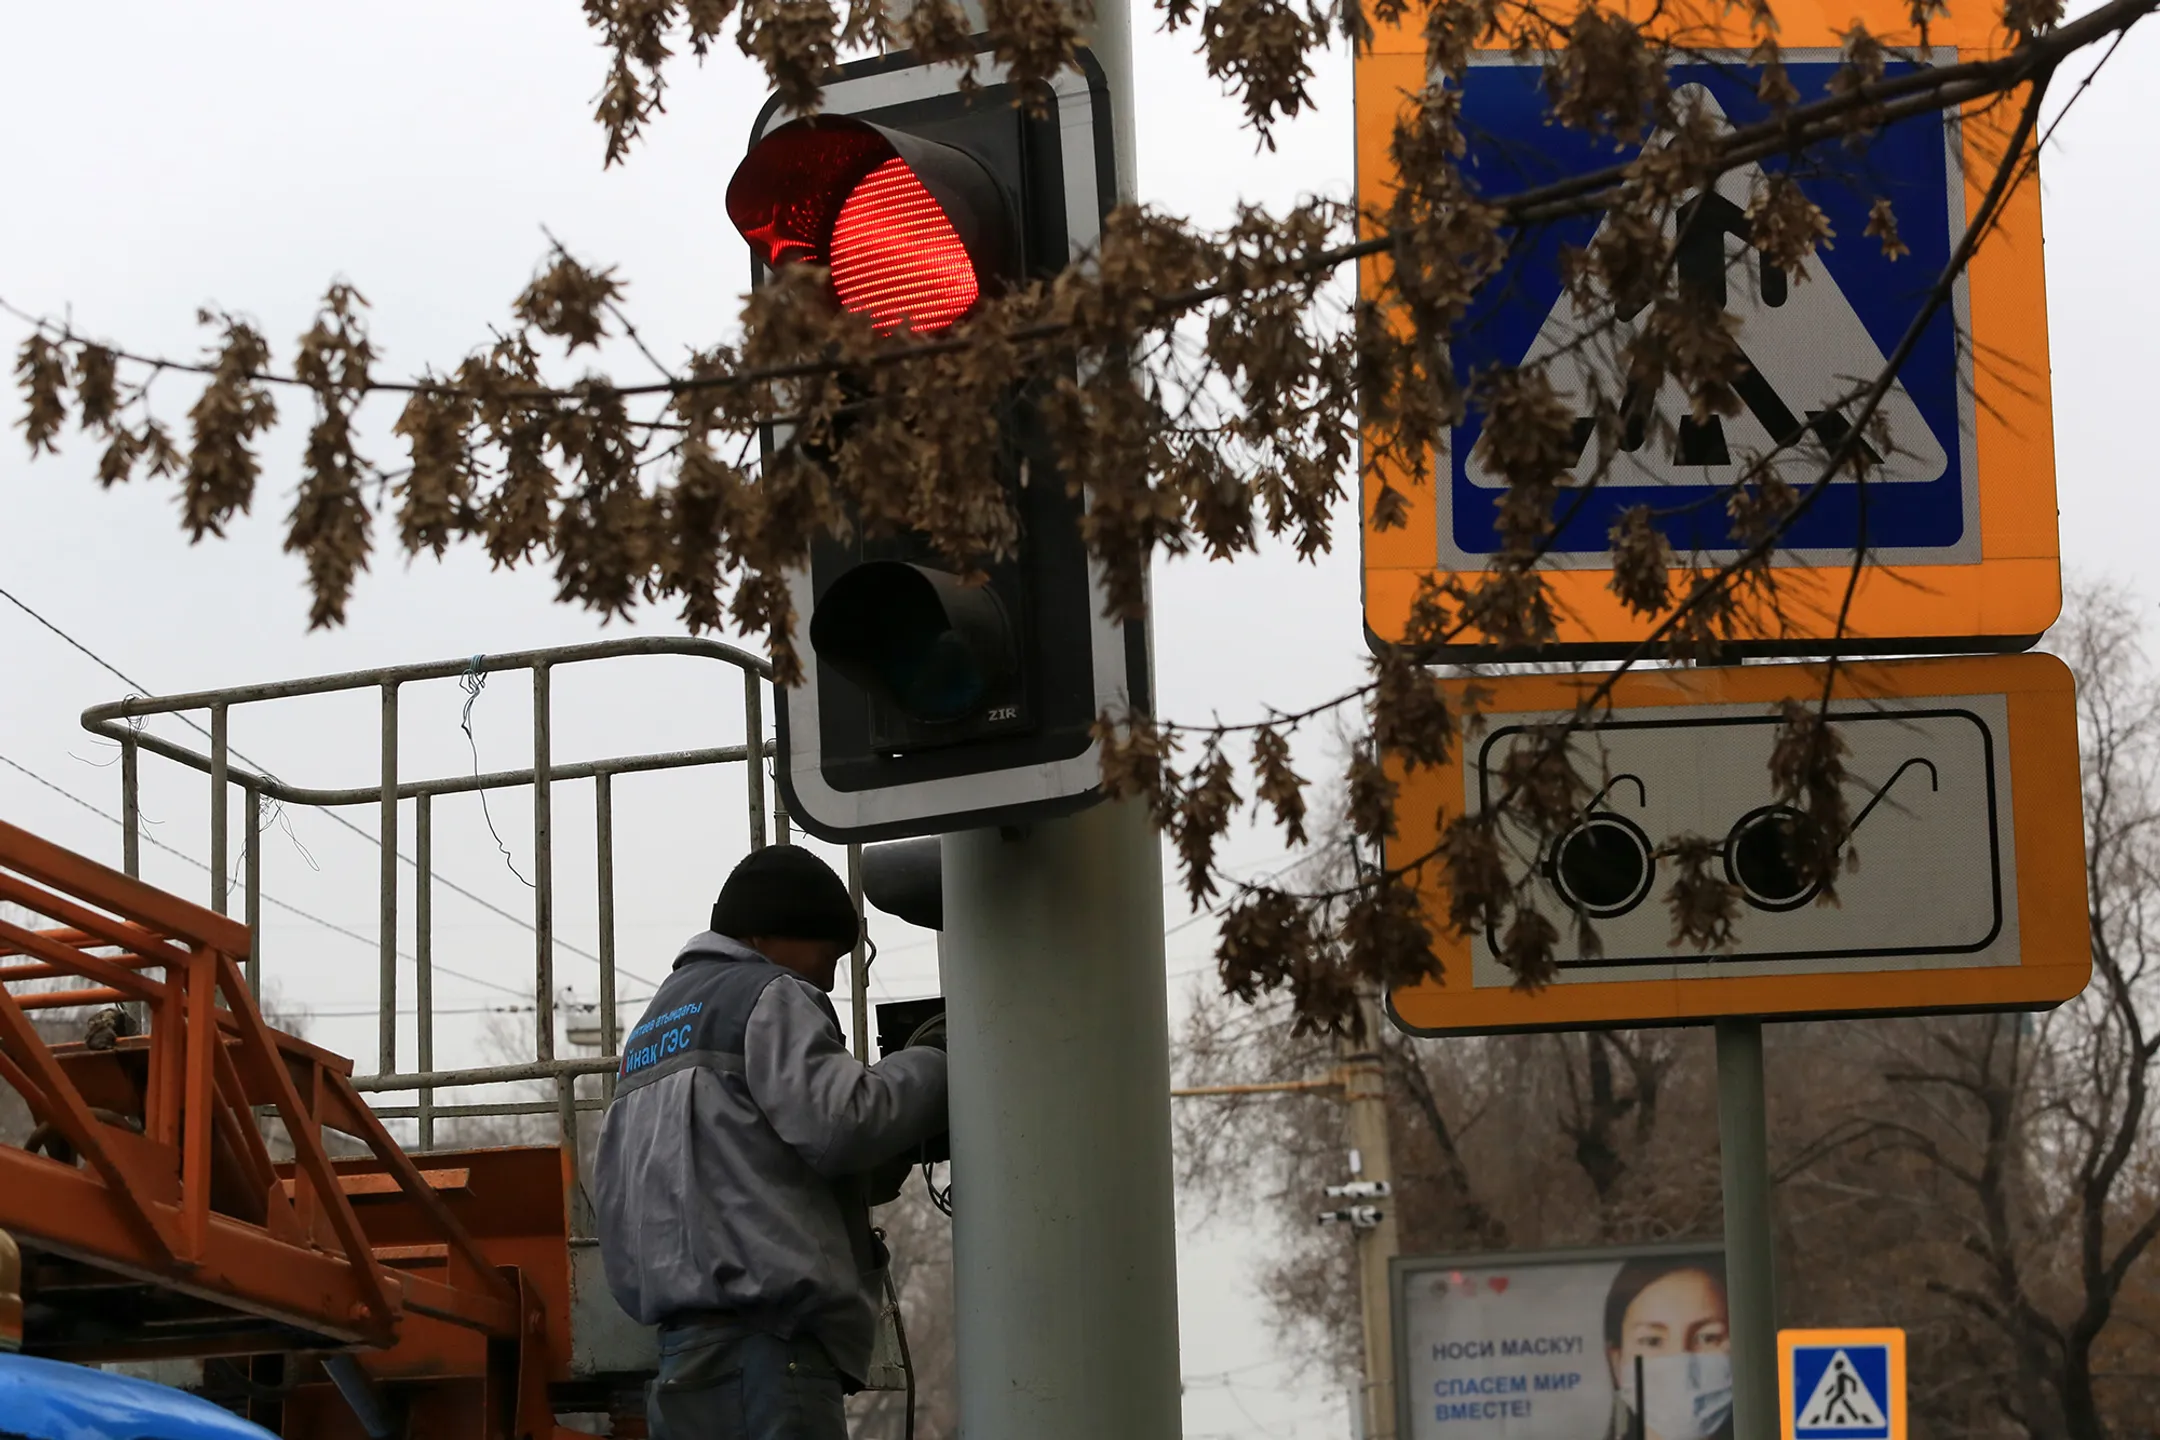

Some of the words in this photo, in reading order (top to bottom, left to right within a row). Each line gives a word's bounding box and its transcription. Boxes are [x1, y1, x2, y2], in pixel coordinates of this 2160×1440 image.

[988, 708, 1017, 721] ZIR
[659, 1024, 692, 1057] ГЭС
[1432, 1341, 1495, 1361] НОСИ
[1501, 1336, 1583, 1357] МАСКУ!
[1434, 1375, 1527, 1397] СПАСЕМ
[1534, 1372, 1582, 1393] МИР
[1435, 1400, 1532, 1422] ВМЕСТЕ!
